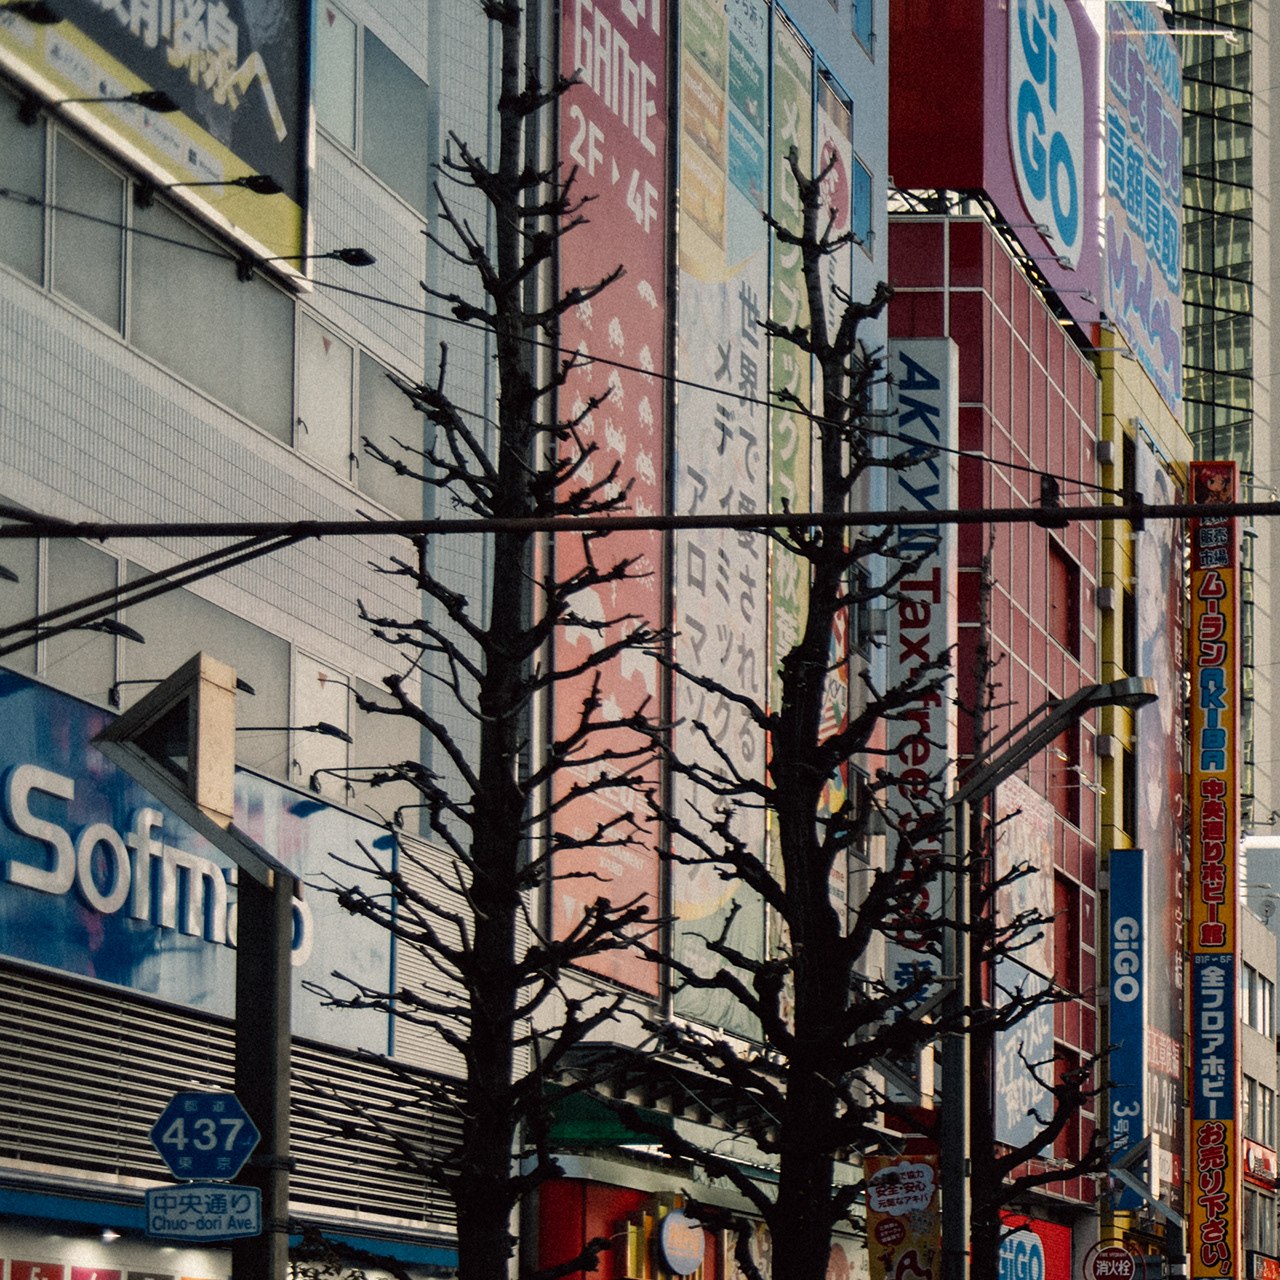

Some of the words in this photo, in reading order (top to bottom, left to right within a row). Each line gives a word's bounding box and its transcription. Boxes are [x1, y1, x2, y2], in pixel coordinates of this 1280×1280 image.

[574, 0, 657, 157] GAME
[570, 104, 605, 178] 2F
[626, 168, 659, 234] 4F
[1106, 108, 1181, 287] 高額買取
[1200, 549, 1228, 569] 市場
[7, 763, 314, 967] Sofm
[1199, 778, 1226, 946] 中央通りホビー館
[1114, 916, 1140, 1002] GiGO
[1200, 965, 1227, 1119] 全フロアホビー
[162, 1118, 245, 1151] 437
[184, 1101, 226, 1113] 都道
[153, 1193, 252, 1215] 中央通り
[179, 1157, 232, 1170] 東京
[1198, 1122, 1231, 1275] お売り下さい!
[152, 1215, 222, 1231] Chuo-dori
[227, 1215, 257, 1231] Ave.
[1096, 1259, 1132, 1277] 消火栓
